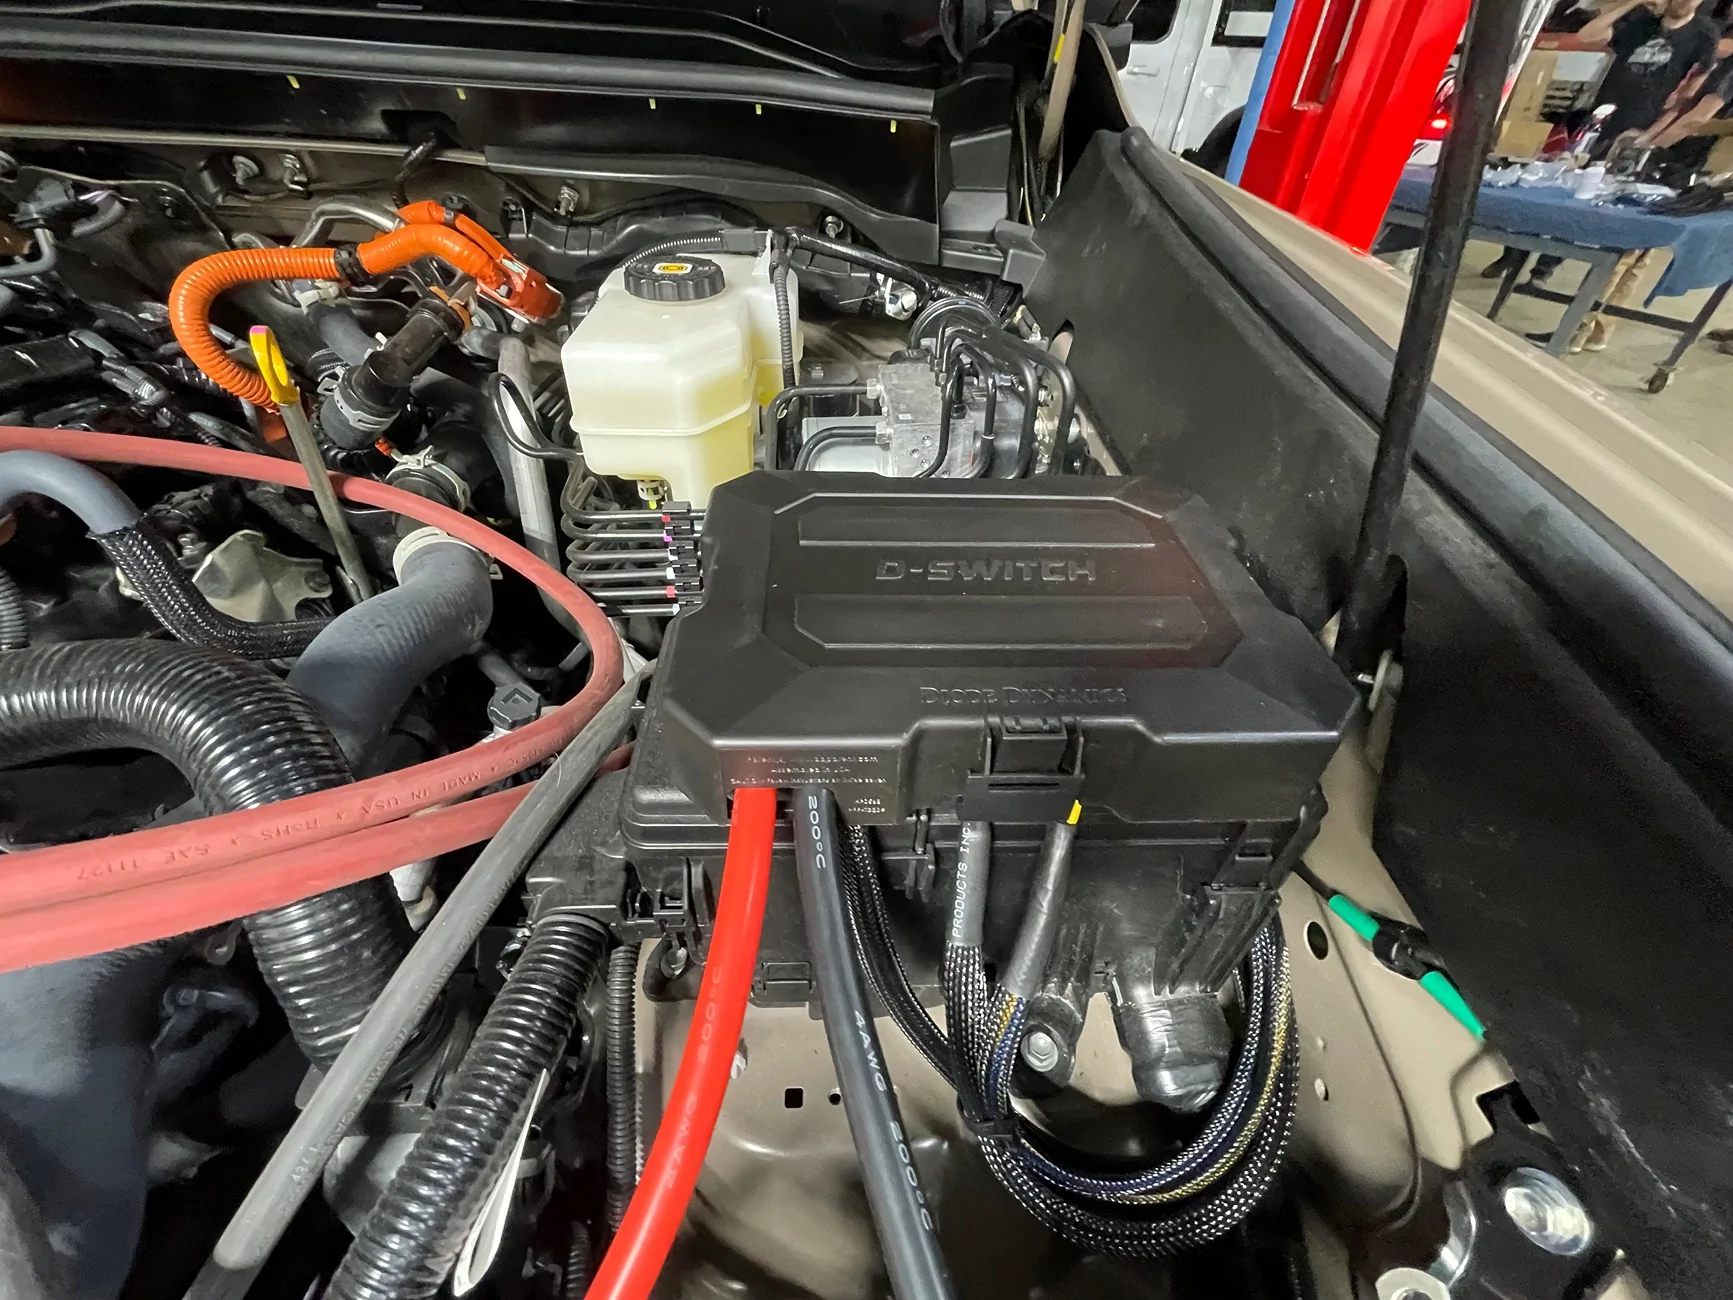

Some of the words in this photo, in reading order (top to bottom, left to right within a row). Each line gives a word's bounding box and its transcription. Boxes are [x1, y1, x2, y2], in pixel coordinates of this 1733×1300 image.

[875, 559, 1097, 582] D-SWITCH
[919, 686, 998, 705] DIODE
[441, 771, 482, 792] MADE
[411, 788, 430, 801] IN
[361, 796, 401, 815] USA
[951, 861, 968, 939] PRODUCTS
[960, 822, 972, 854] INC.
[855, 1010, 888, 1092] 4AWG
